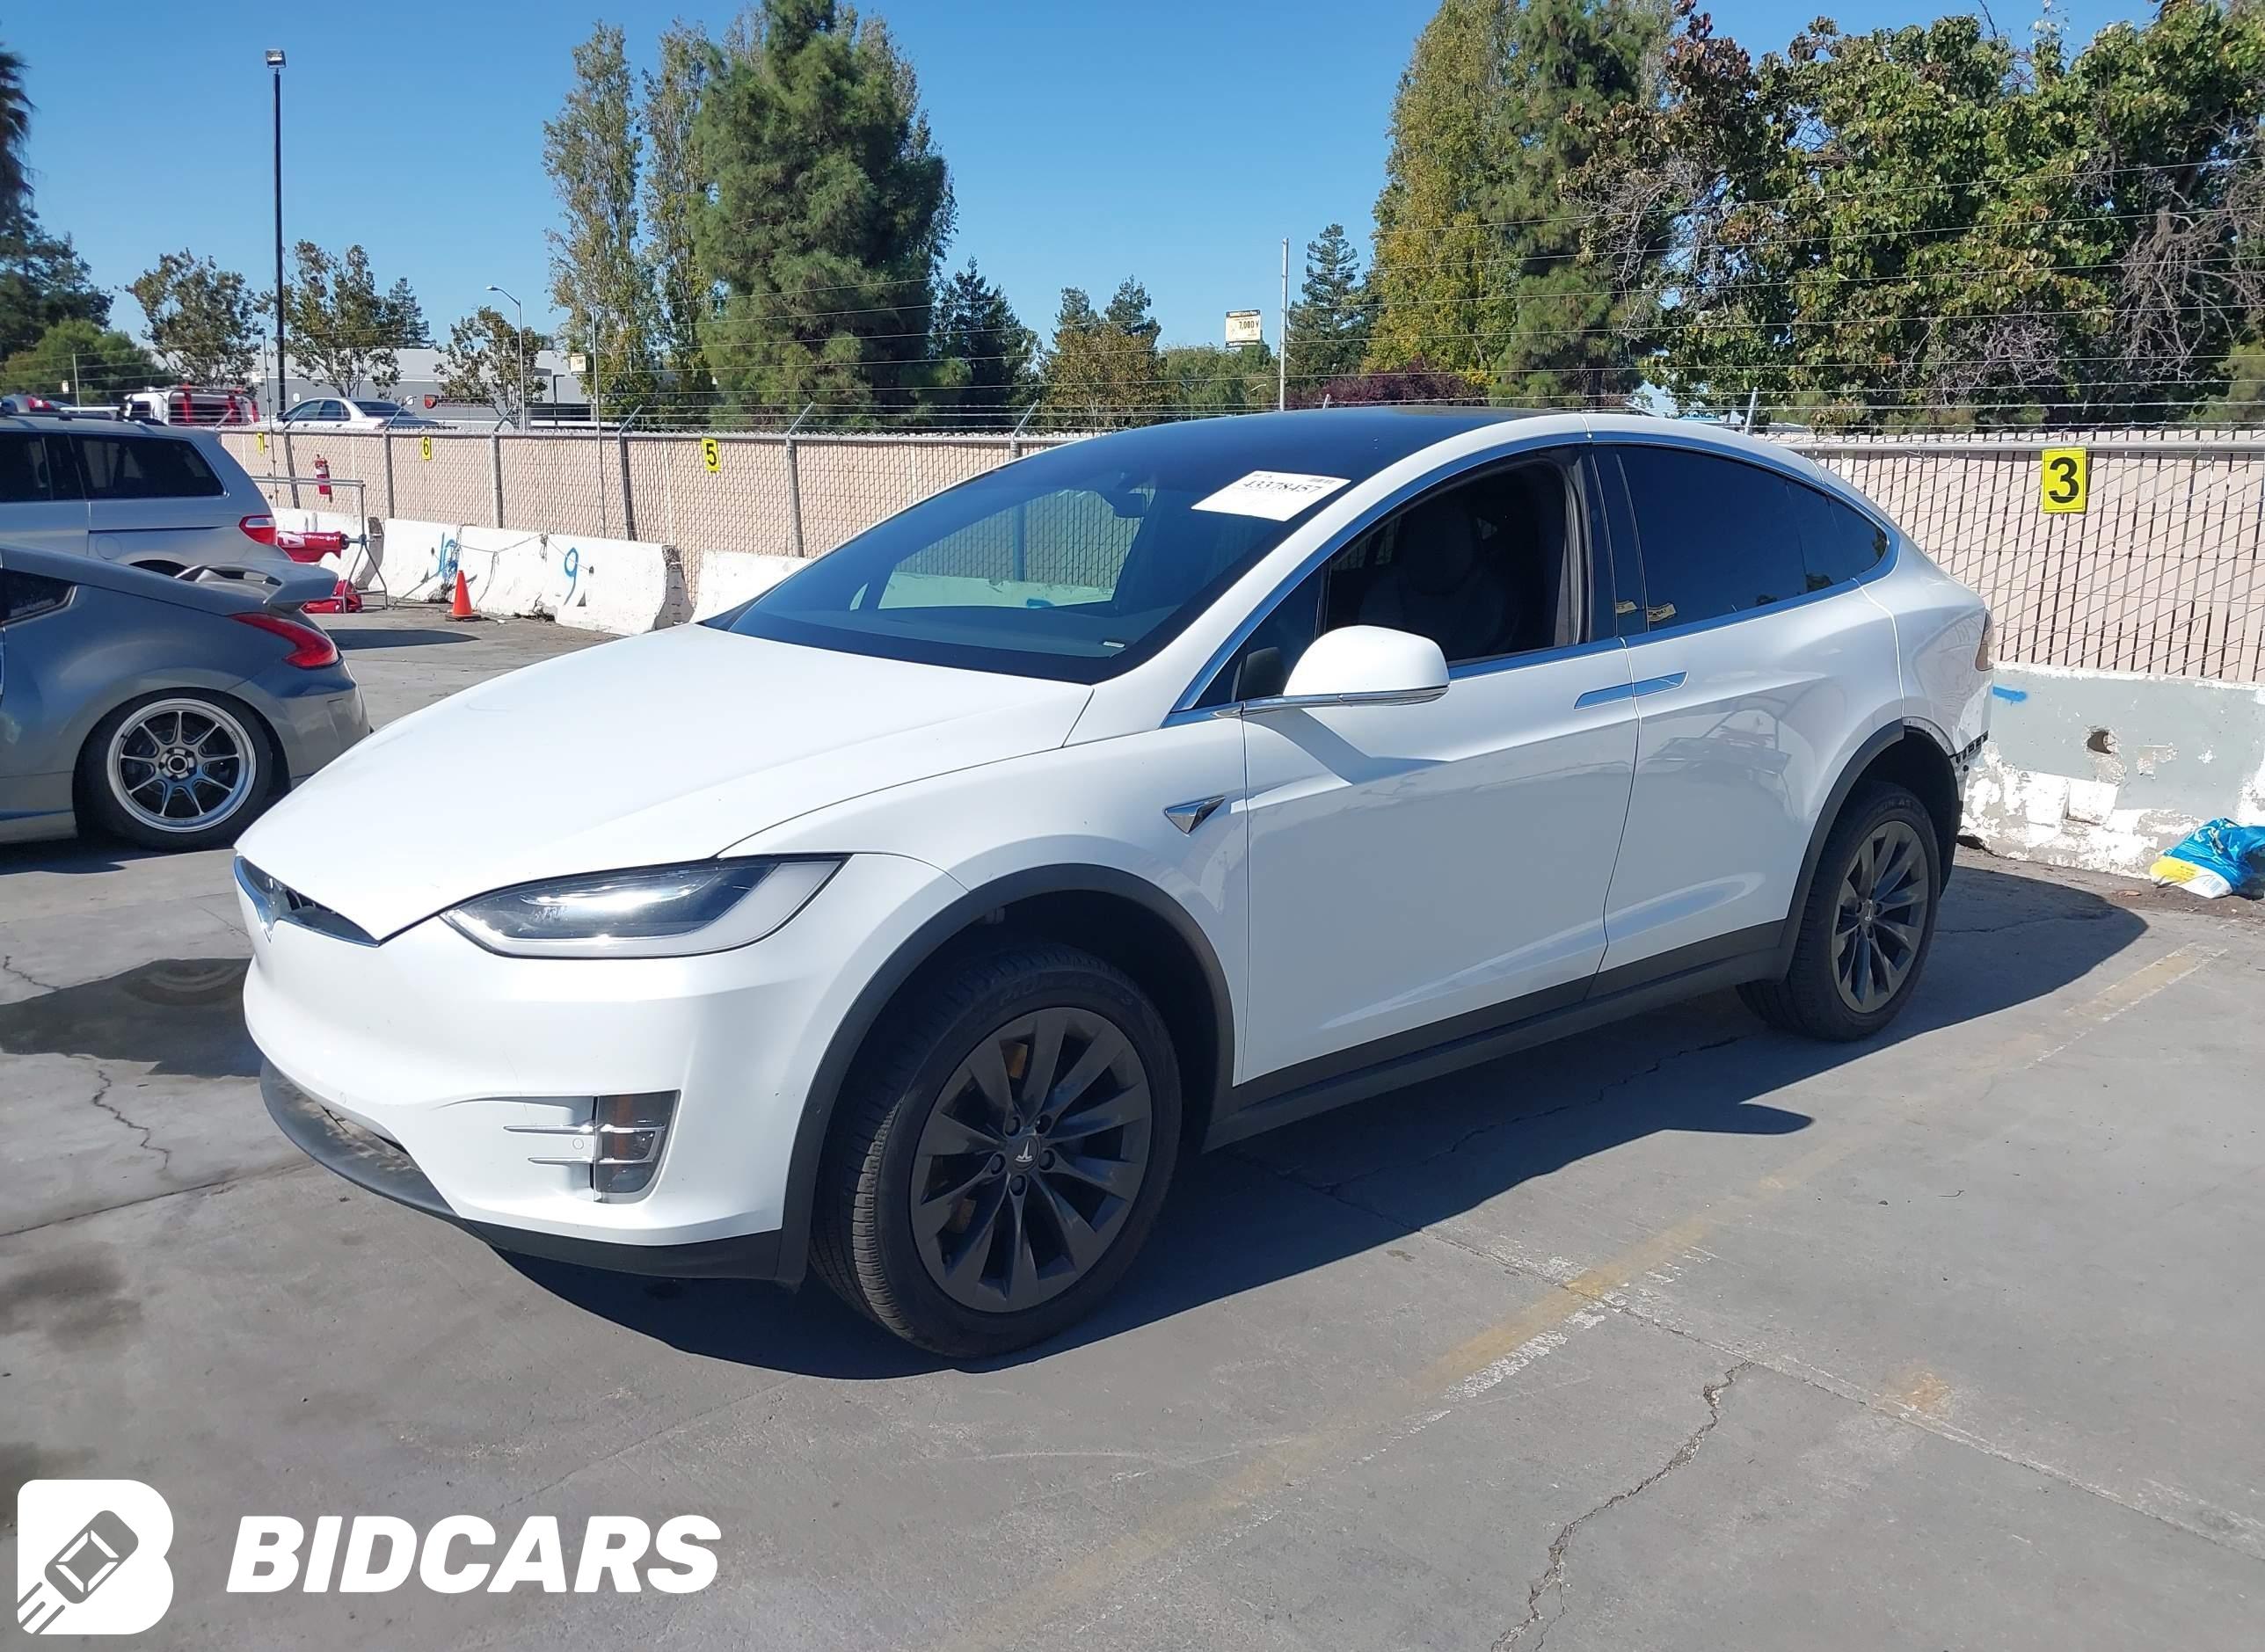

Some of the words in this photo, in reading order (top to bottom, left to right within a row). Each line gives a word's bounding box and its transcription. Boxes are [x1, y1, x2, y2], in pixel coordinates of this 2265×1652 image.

[423, 437, 430, 455] 6
[705, 442, 717, 467] 5
[2048, 456, 2079, 504] 3
[564, 547, 579, 606] 9
